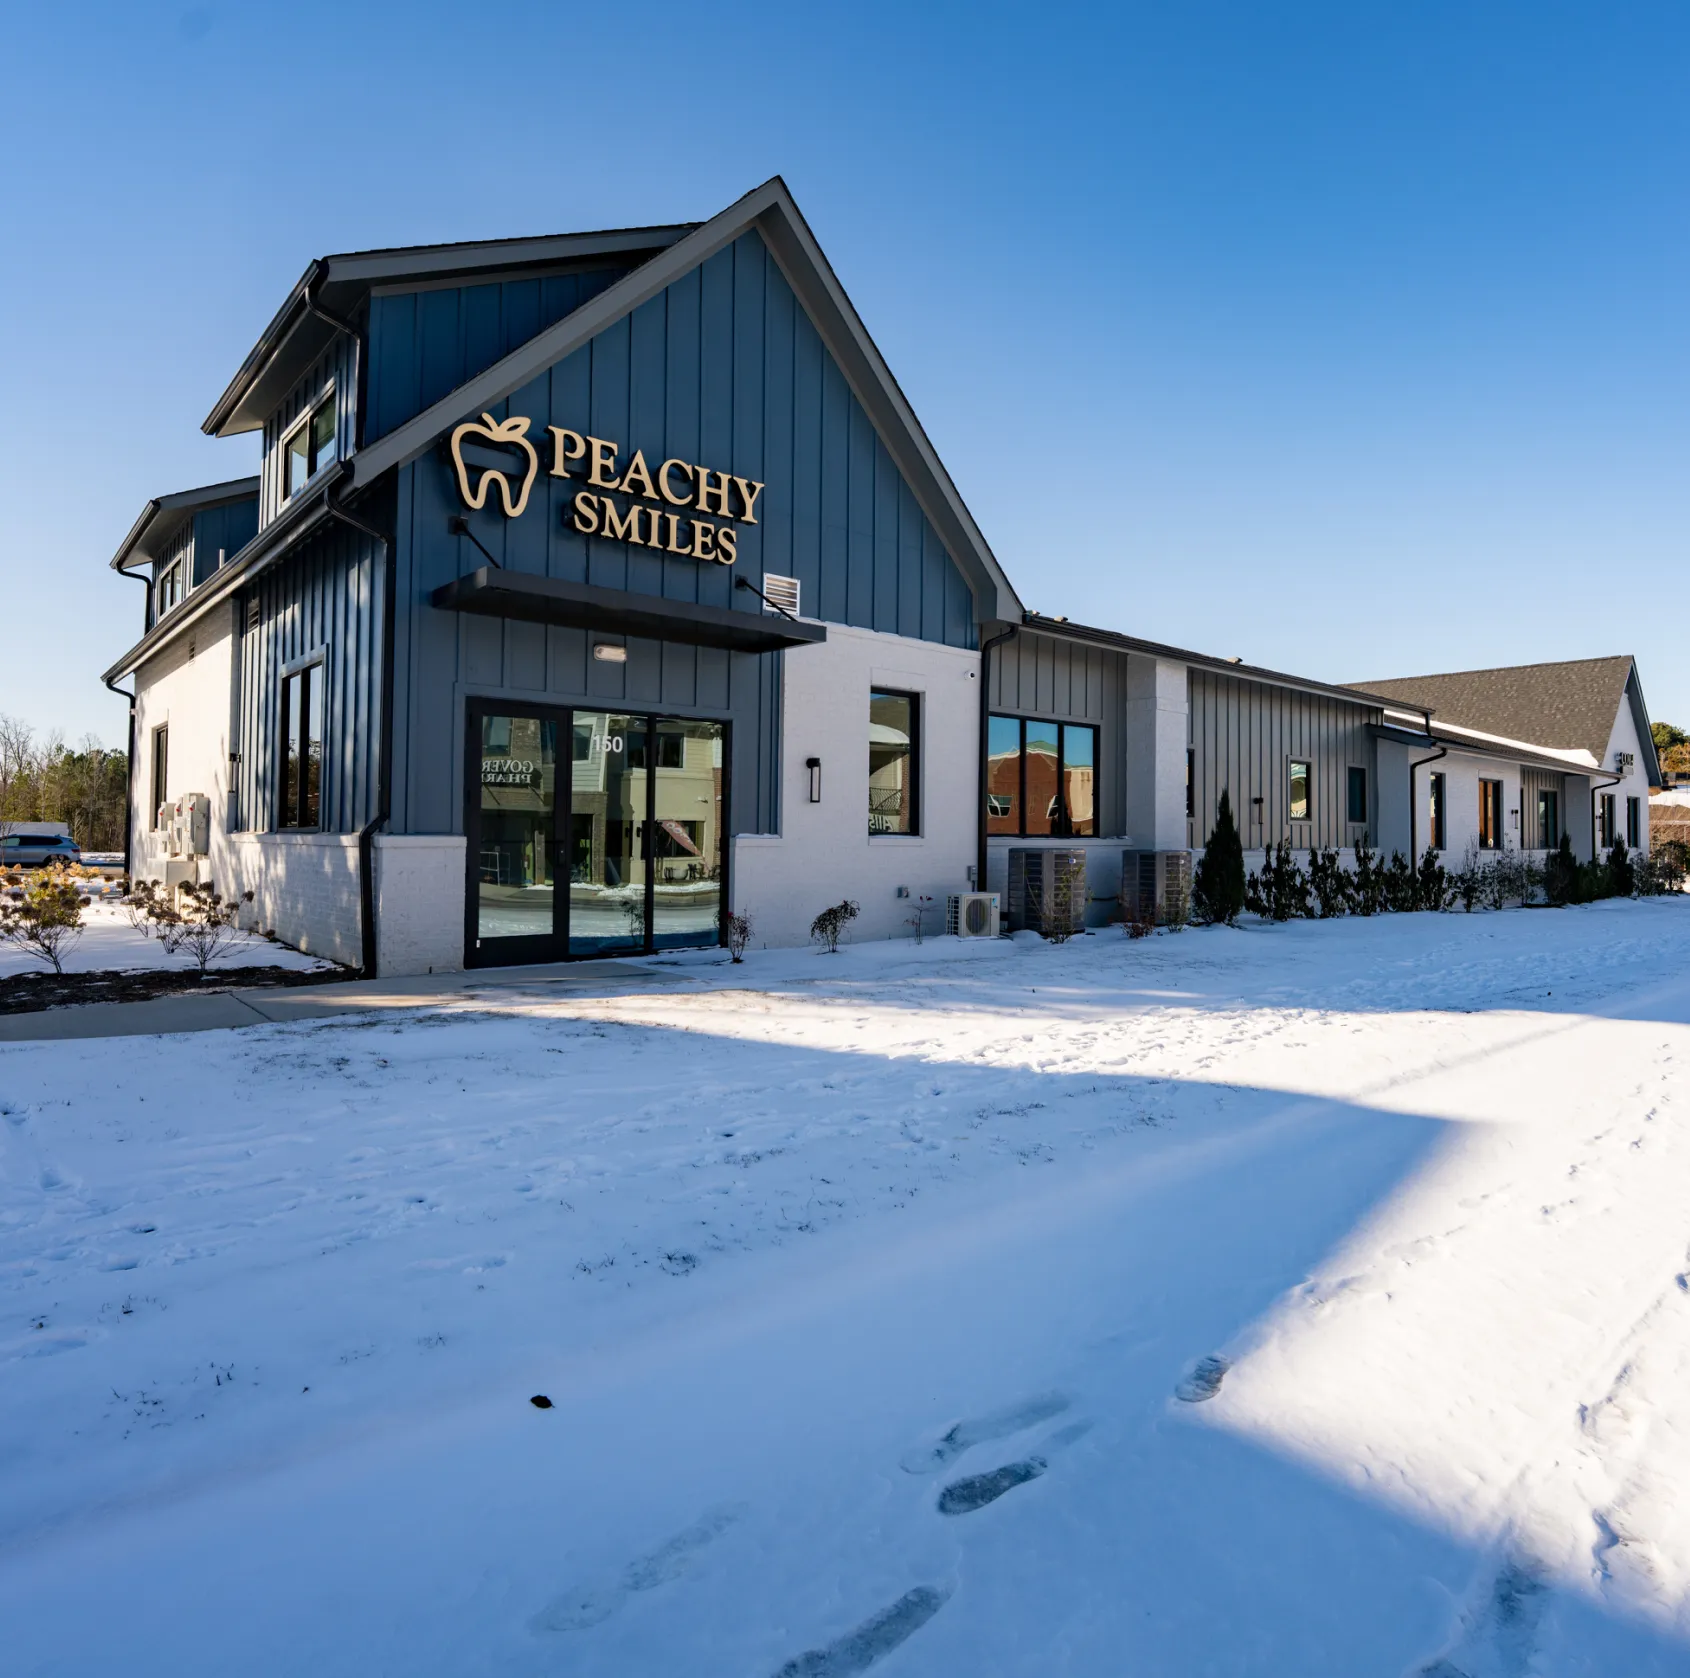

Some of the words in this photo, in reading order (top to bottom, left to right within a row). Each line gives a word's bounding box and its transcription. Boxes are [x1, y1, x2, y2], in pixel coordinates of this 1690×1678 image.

[548, 425, 765, 524] PEACHY
[574, 491, 737, 565] SMILES
[593, 735, 623, 753] 150
